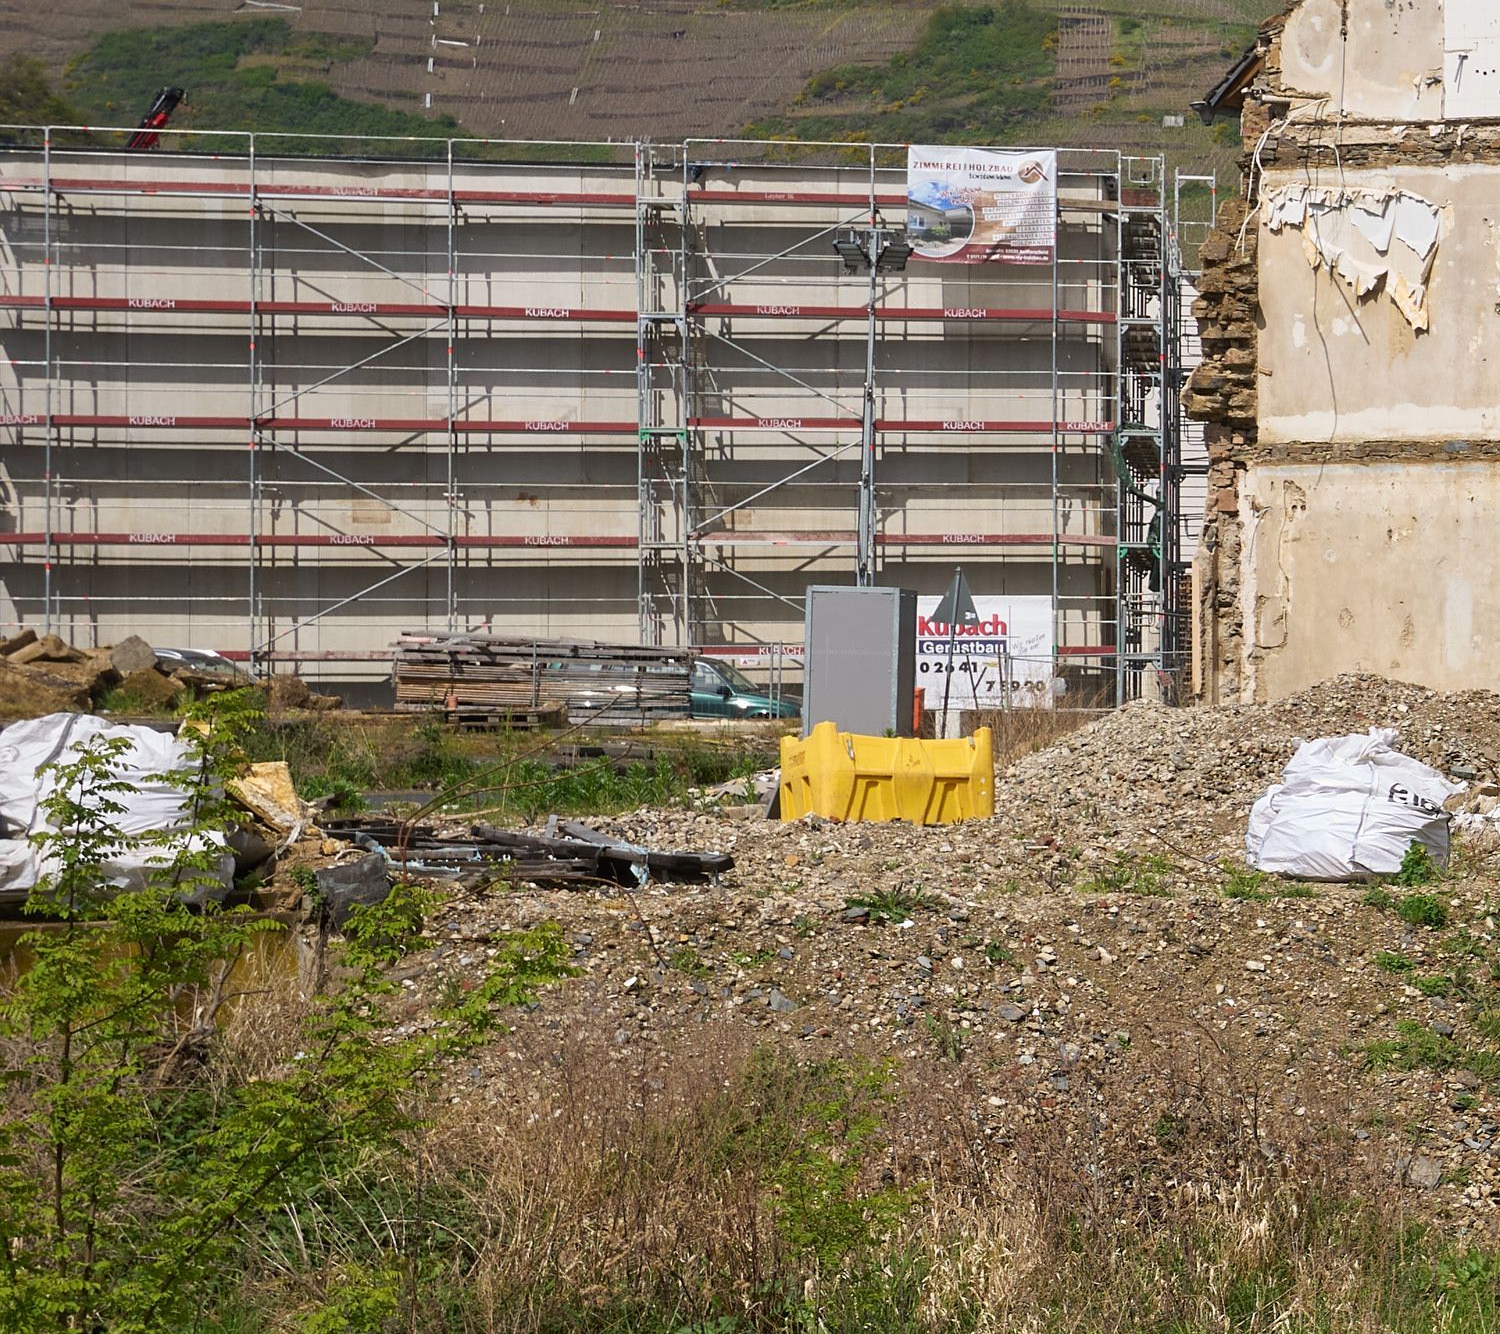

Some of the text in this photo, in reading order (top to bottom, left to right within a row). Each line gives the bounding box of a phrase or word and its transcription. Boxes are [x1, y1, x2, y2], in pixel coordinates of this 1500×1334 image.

[913, 161, 1013, 173] ZIMMEREI HOLZBAU
[128, 298, 175, 308] KUBACH
[332, 302, 377, 312] KUBACH
[525, 307, 569, 317] KUBACH
[757, 306, 800, 315] KUBACH
[944, 308, 986, 318] KUBACH
[129, 417, 175, 426] KUBACH
[331, 419, 376, 428] KUBACH
[525, 421, 569, 430] KUBACH
[758, 419, 801, 428] KUBACH
[943, 421, 984, 430] KUBACH
[1067, 421, 1108, 430] KUBACH
[129, 534, 175, 543] KUBACH
[330, 535, 374, 544] KUBACH
[525, 536, 569, 545] KUBACH
[943, 534, 984, 543] KUBACH
[759, 646, 801, 655] KUBACH
[923, 640, 1004, 653] Gerüstbau
